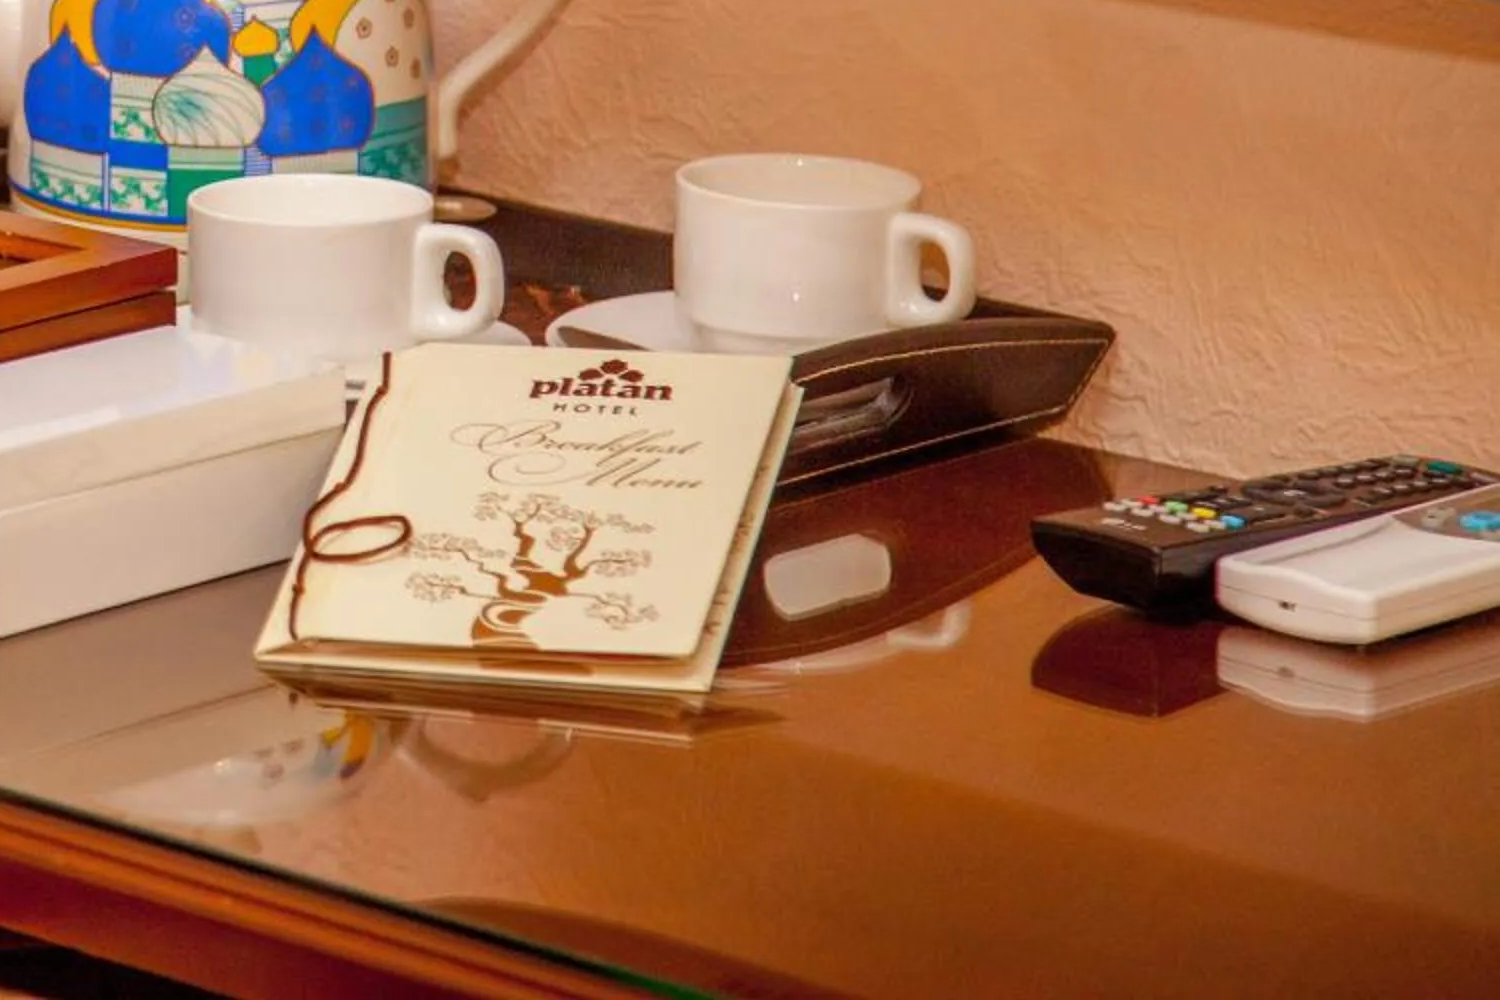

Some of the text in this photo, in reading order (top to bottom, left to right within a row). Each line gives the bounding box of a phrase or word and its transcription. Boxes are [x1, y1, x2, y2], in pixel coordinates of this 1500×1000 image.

[529, 377, 673, 400] platan
[553, 402, 638, 416] HOTEL
[450, 420, 703, 467] Breakfast
